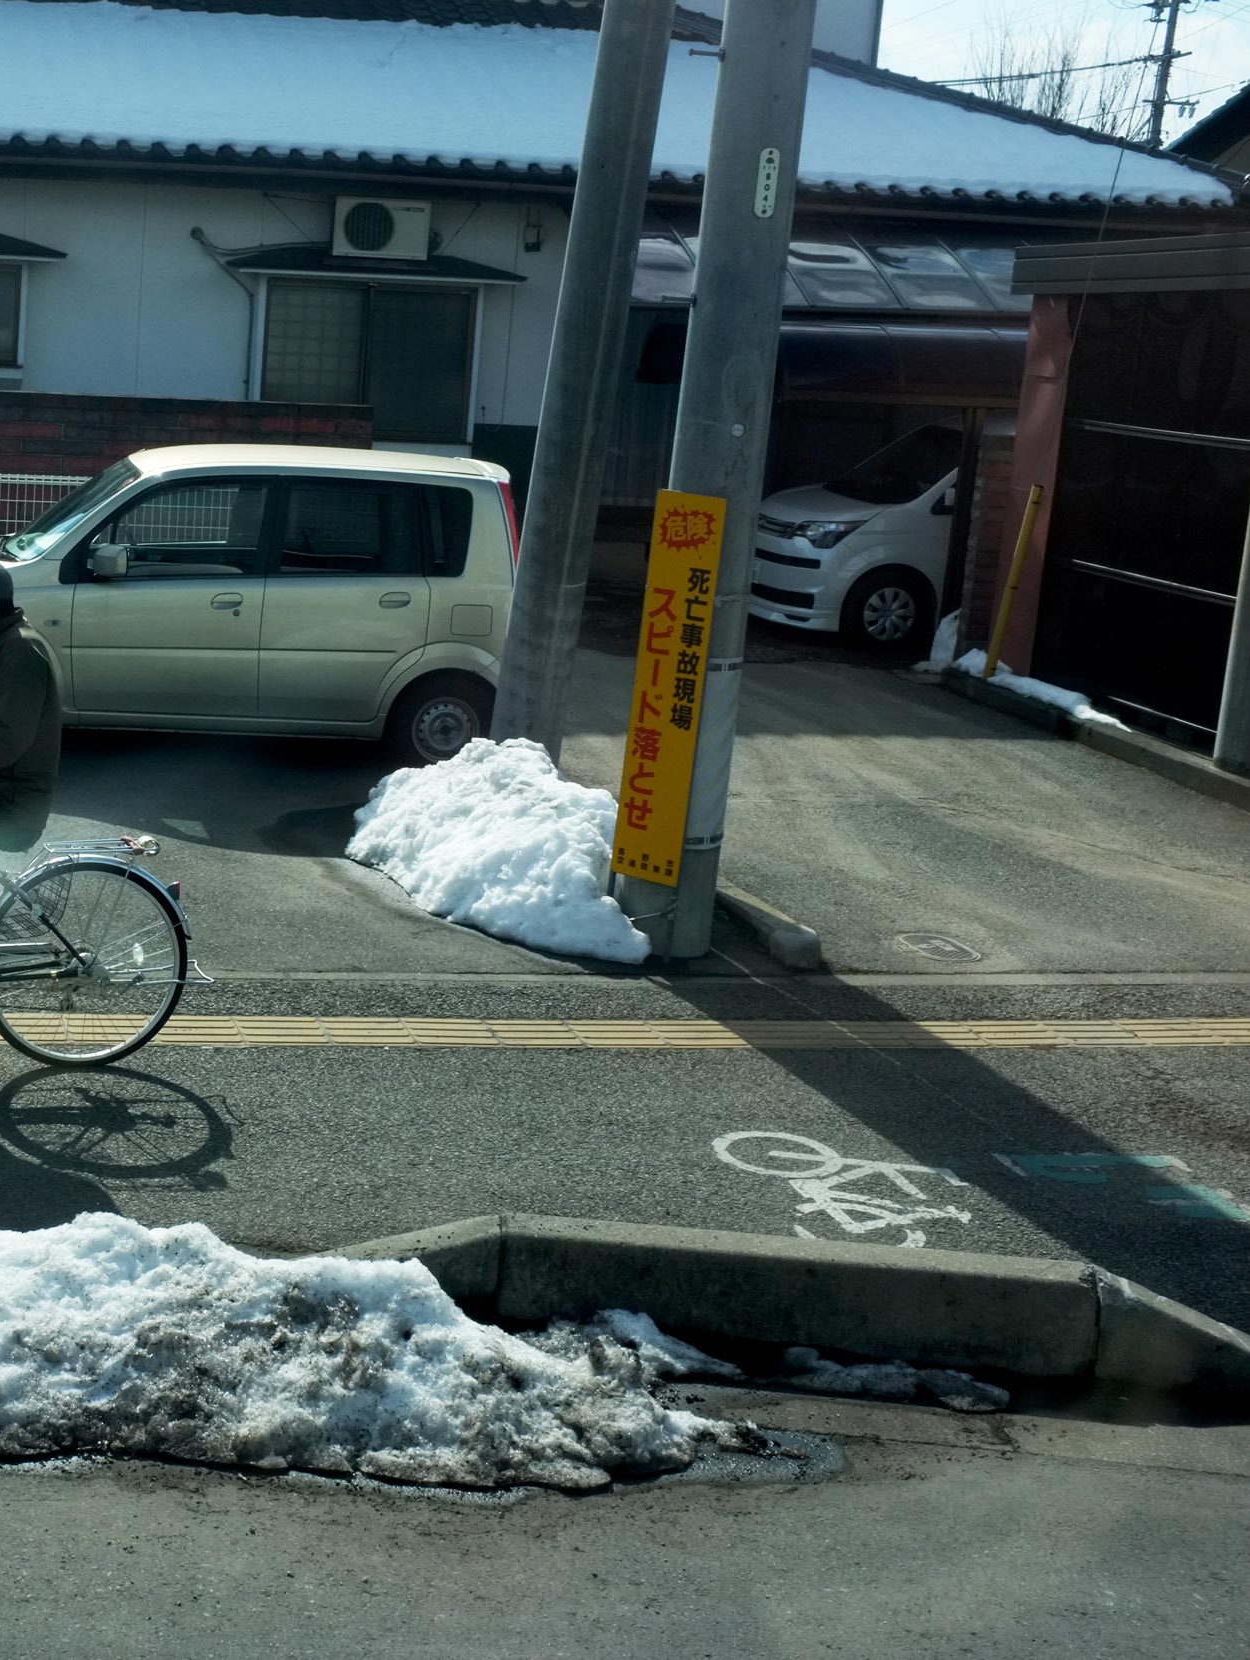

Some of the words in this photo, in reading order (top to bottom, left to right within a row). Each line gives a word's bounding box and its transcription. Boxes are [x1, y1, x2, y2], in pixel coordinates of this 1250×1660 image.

[762, 172, 771, 203] 804
[665, 514, 709, 541] 危険
[669, 567, 711, 731] 死亡事故現場
[624, 587, 677, 831] スピード落とせ
